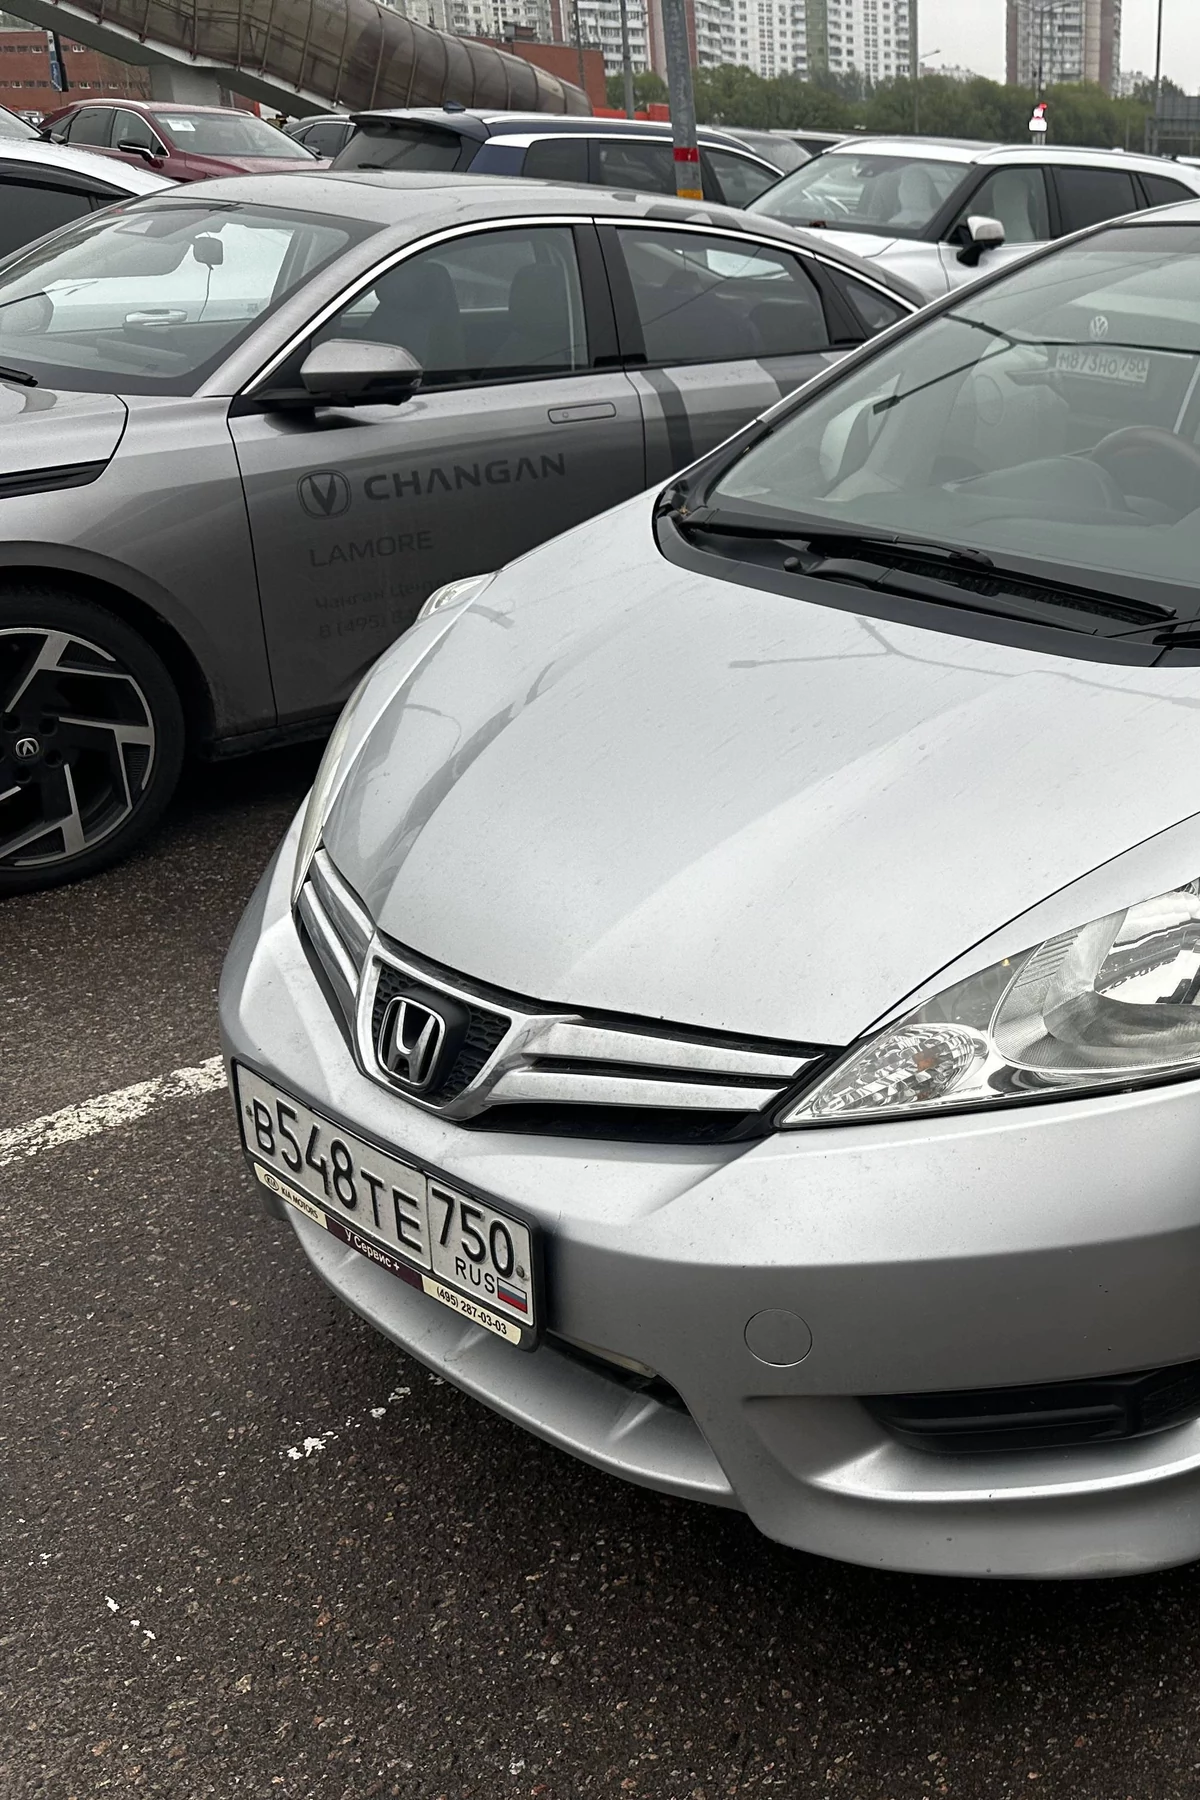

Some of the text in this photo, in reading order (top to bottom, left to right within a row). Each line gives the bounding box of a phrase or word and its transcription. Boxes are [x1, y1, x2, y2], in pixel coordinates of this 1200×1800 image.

[363, 453, 566, 501] CHANGAN
[309, 530, 434, 567] LAMORE
[281, 1186, 319, 1219] KIA MOTORS
[353, 1236, 392, 1268] Сервис
[431, 1186, 515, 1279] 750
[455, 1255, 496, 1295] RUS
[436, 1286, 507, 1335] (495) 287-03-03
